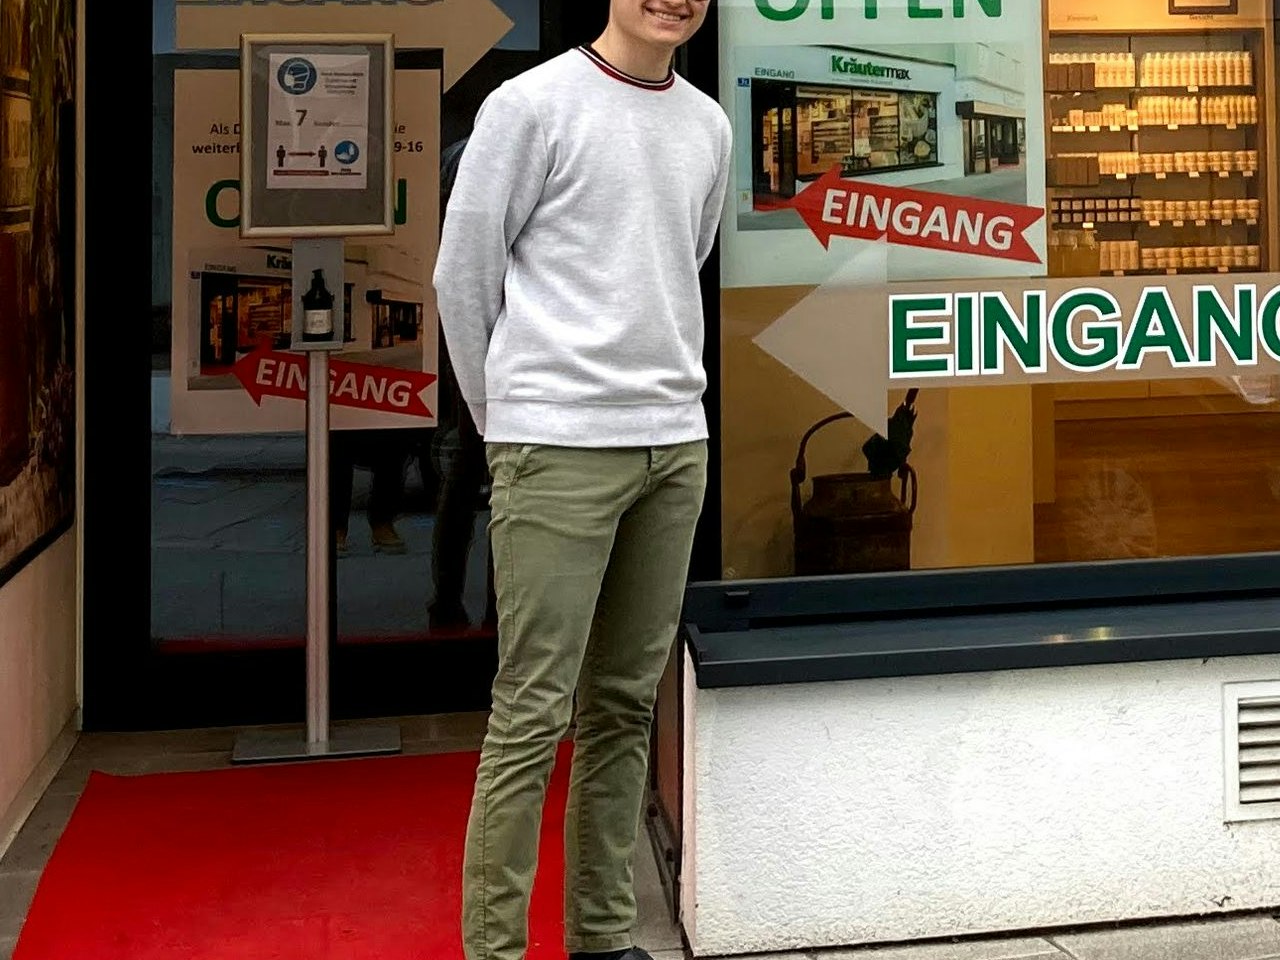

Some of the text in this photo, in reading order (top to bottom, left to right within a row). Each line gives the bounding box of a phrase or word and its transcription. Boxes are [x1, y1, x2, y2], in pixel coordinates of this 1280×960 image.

[296, 109, 308, 127] 7
[210, 123, 230, 135] Als
[821, 188, 1016, 252] EINGANG
